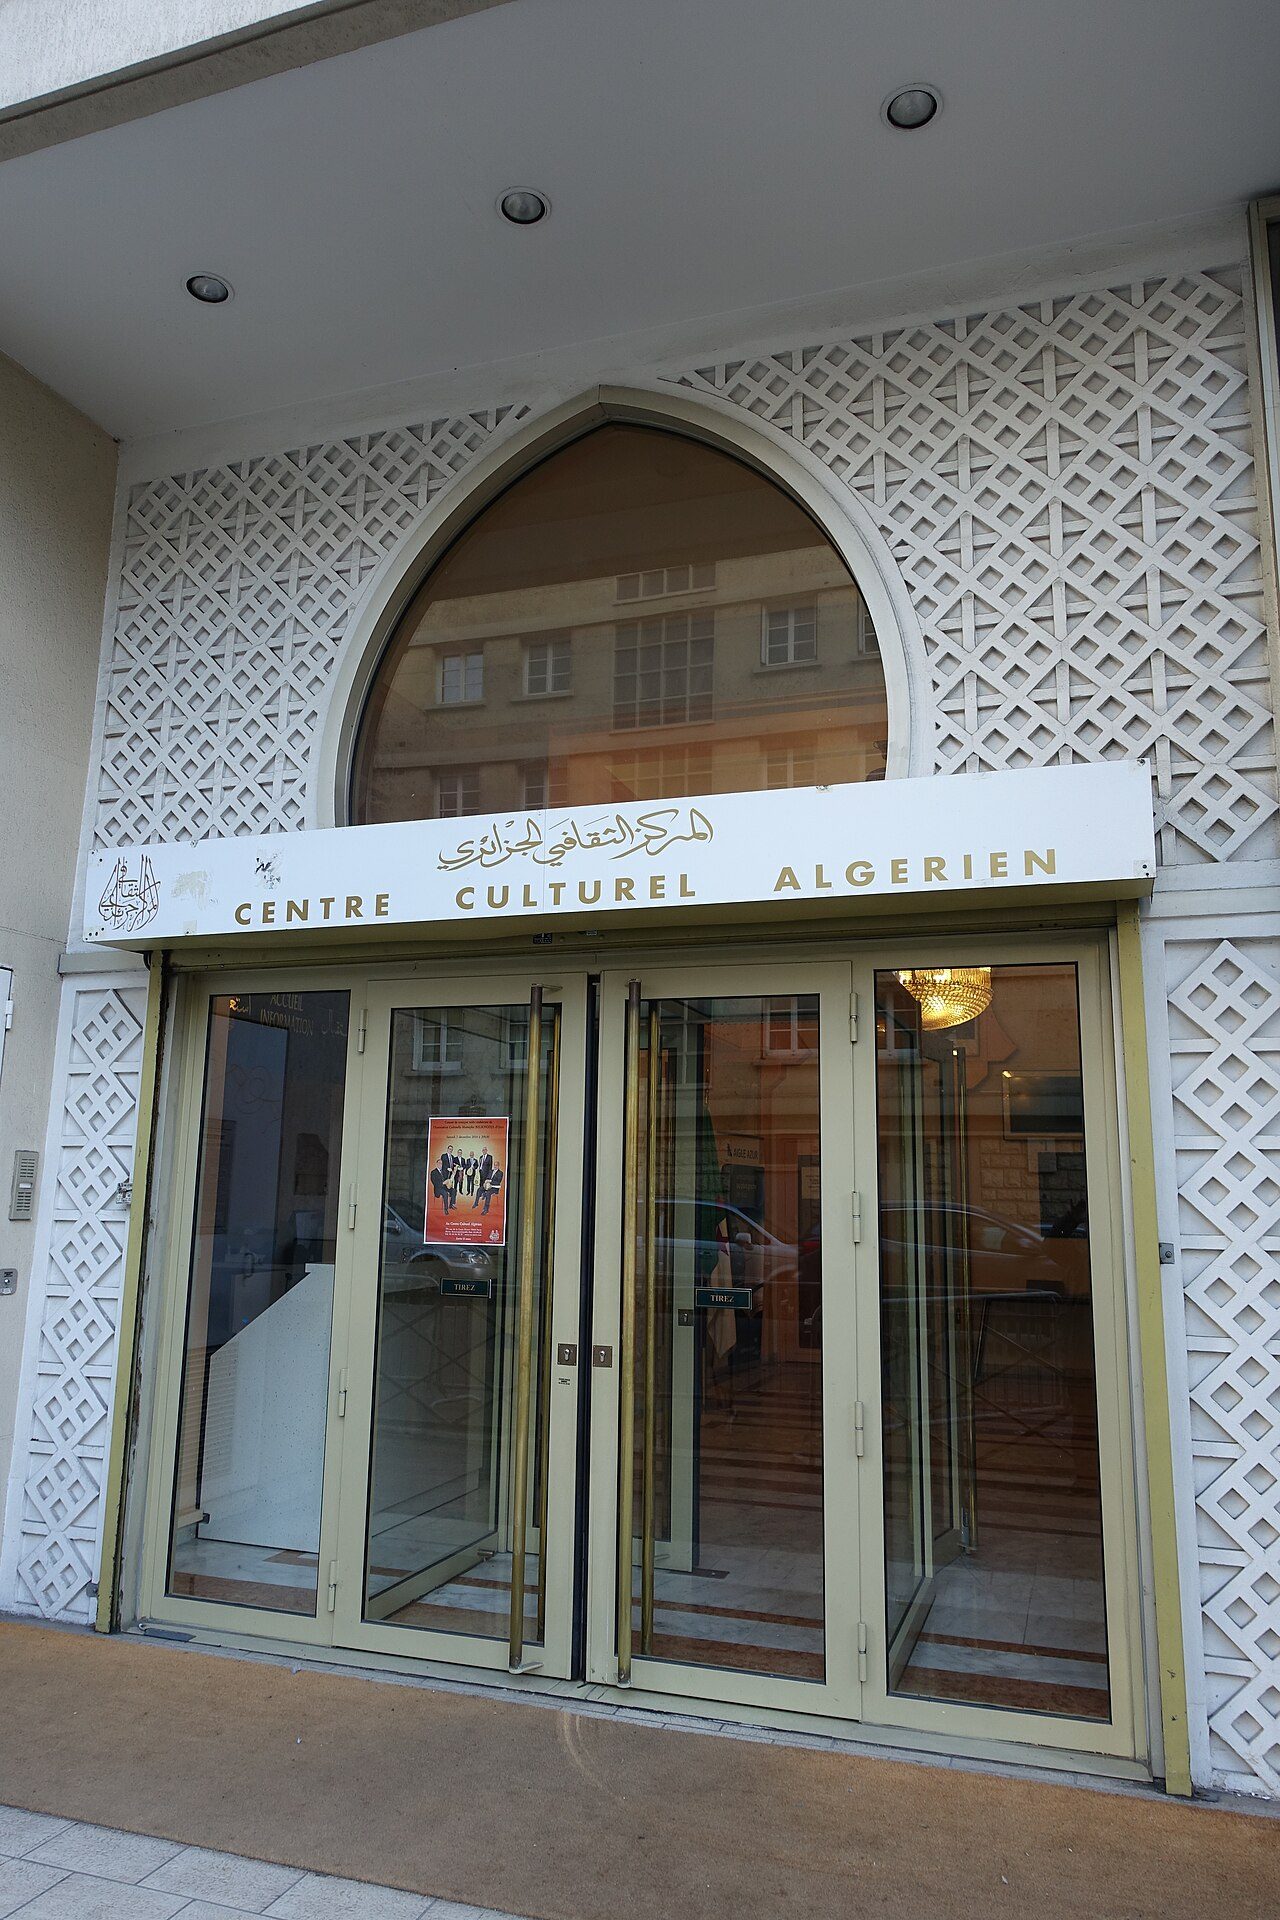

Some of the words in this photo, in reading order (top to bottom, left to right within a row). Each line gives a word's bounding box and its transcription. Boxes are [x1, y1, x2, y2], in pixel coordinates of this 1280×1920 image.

[436, 817, 543, 872] الجزائري
[532, 813, 635, 867] الثقافي
[608, 807, 714, 861] المركز
[234, 892, 391, 926] CENTRE
[455, 873, 697, 910] CULTUREL
[773, 848, 1058, 892] ALGERIEN
[454, 1283, 475, 1291] TIREZ
[710, 1294, 735, 1303] TIREZ
